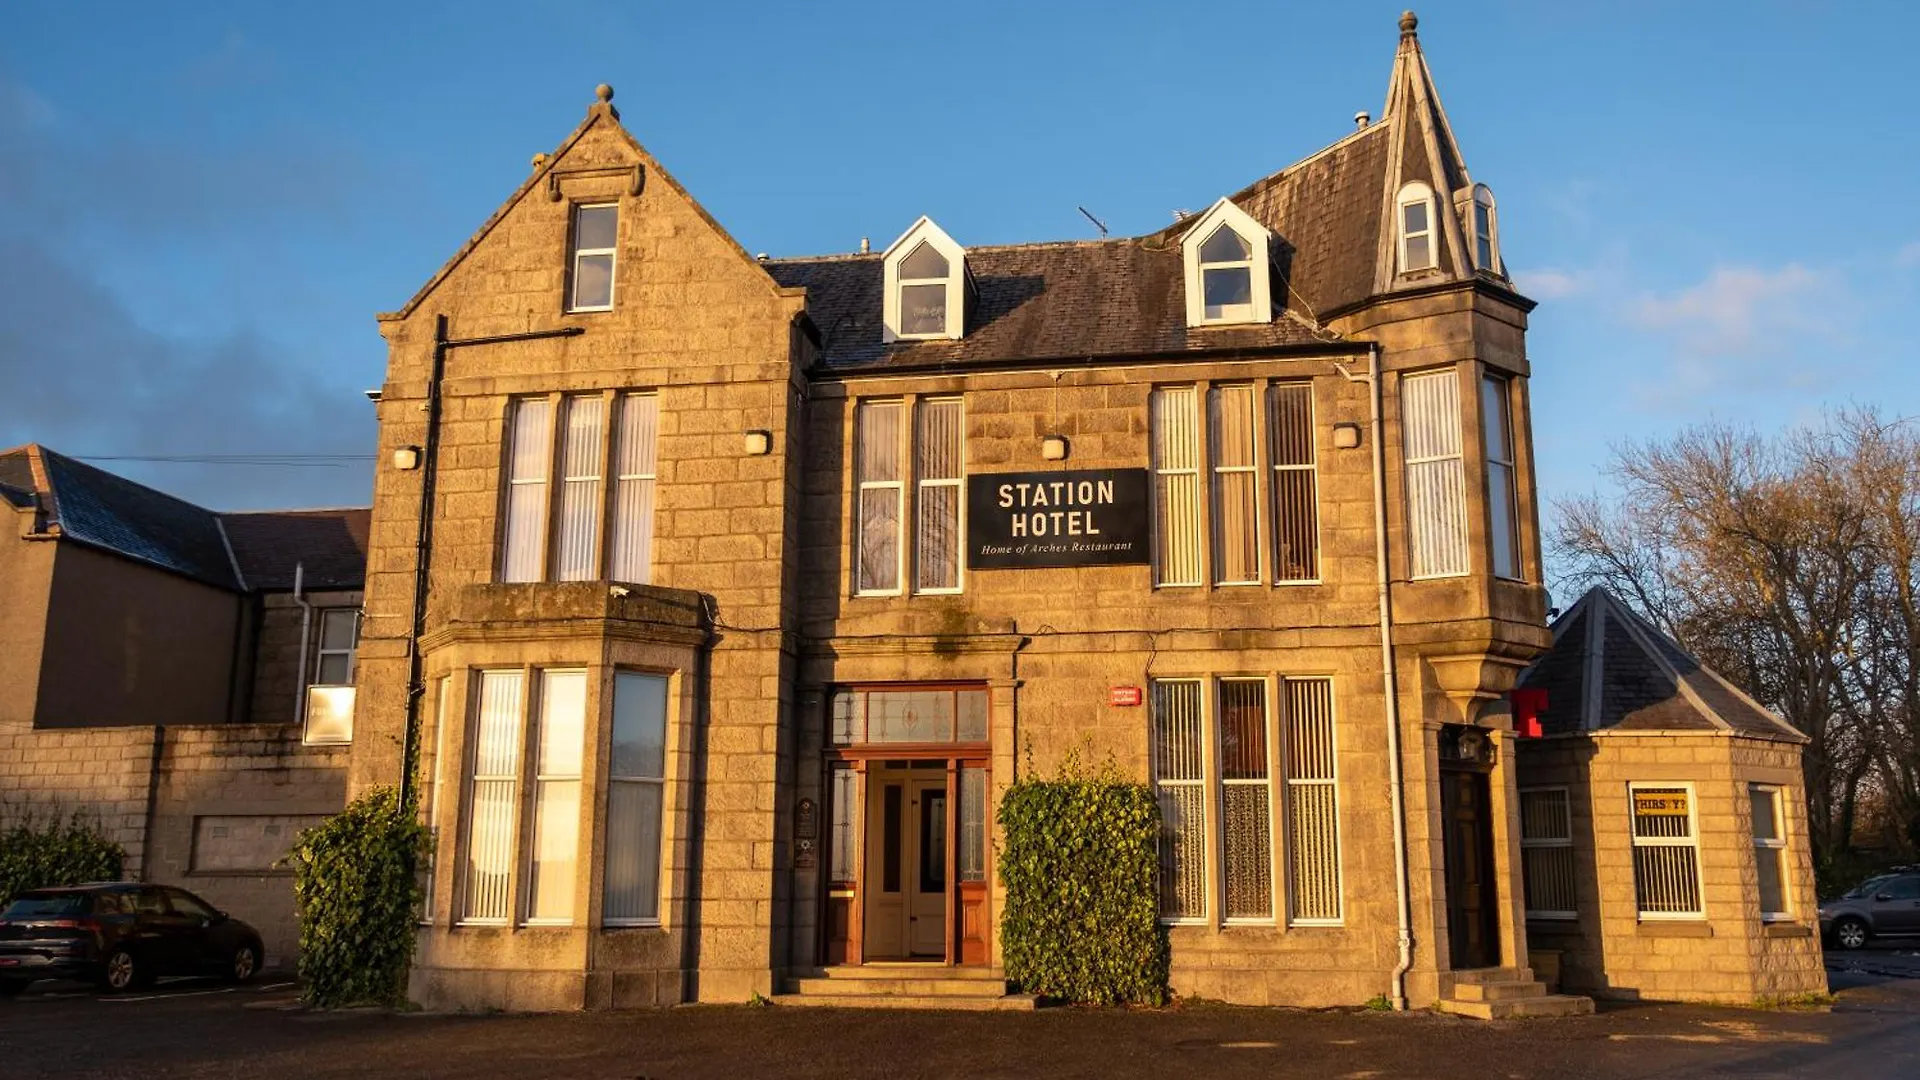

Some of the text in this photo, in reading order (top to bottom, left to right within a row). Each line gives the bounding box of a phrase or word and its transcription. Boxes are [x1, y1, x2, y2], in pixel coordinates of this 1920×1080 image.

[999, 480, 1113, 508] STATION
[1012, 511, 1100, 537] HOTEL
[981, 541, 1133, 555] Home of Arches Restaurant
[1635, 799, 1686, 809] HIRSY?
